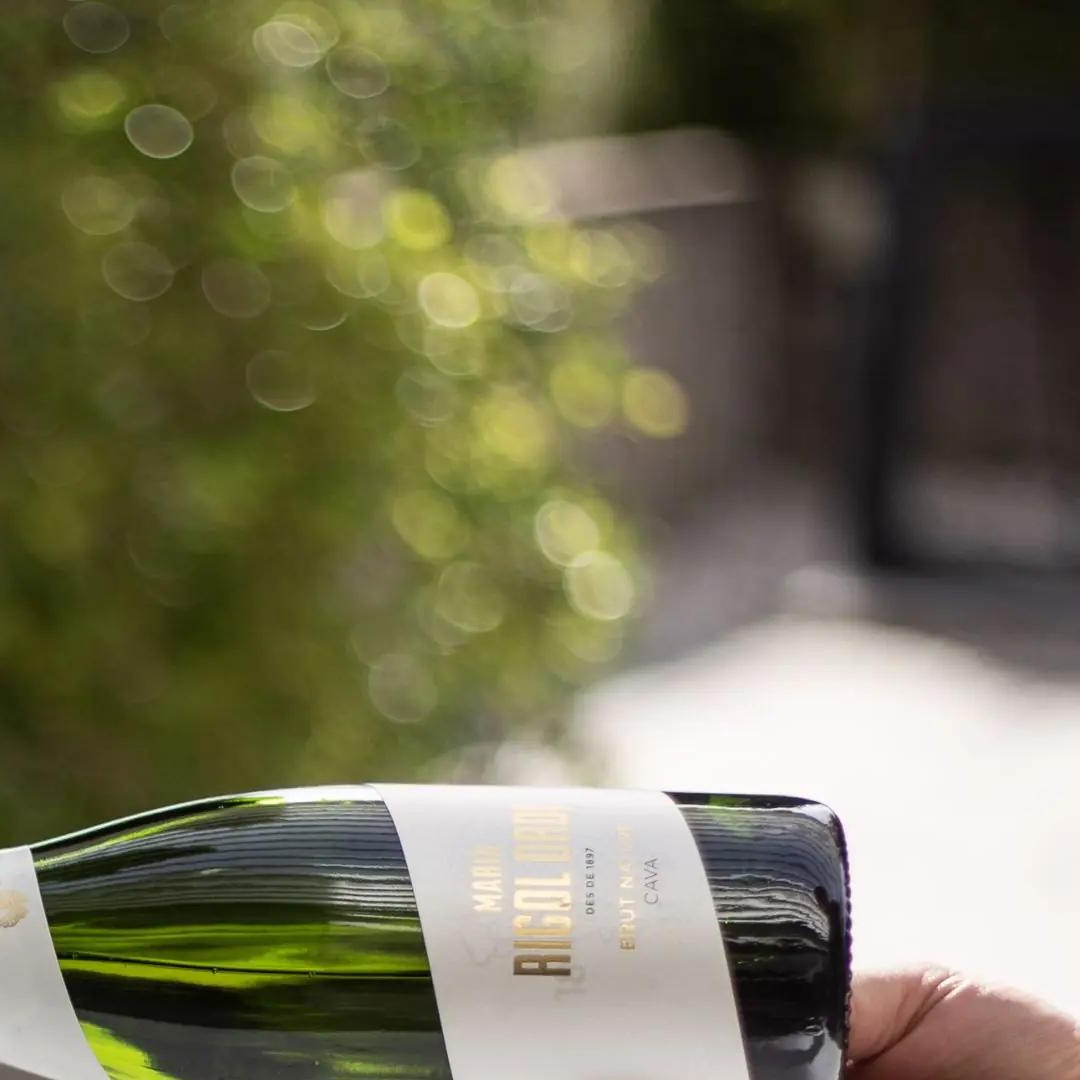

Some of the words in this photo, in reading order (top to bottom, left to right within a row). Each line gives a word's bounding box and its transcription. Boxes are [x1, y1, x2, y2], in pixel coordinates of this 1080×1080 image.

[585, 848, 595, 870] 1897
[585, 874, 595, 888] DE
[644, 858, 660, 904] CAVA
[585, 892, 595, 915] DES
[619, 897, 636, 950] BRUT
